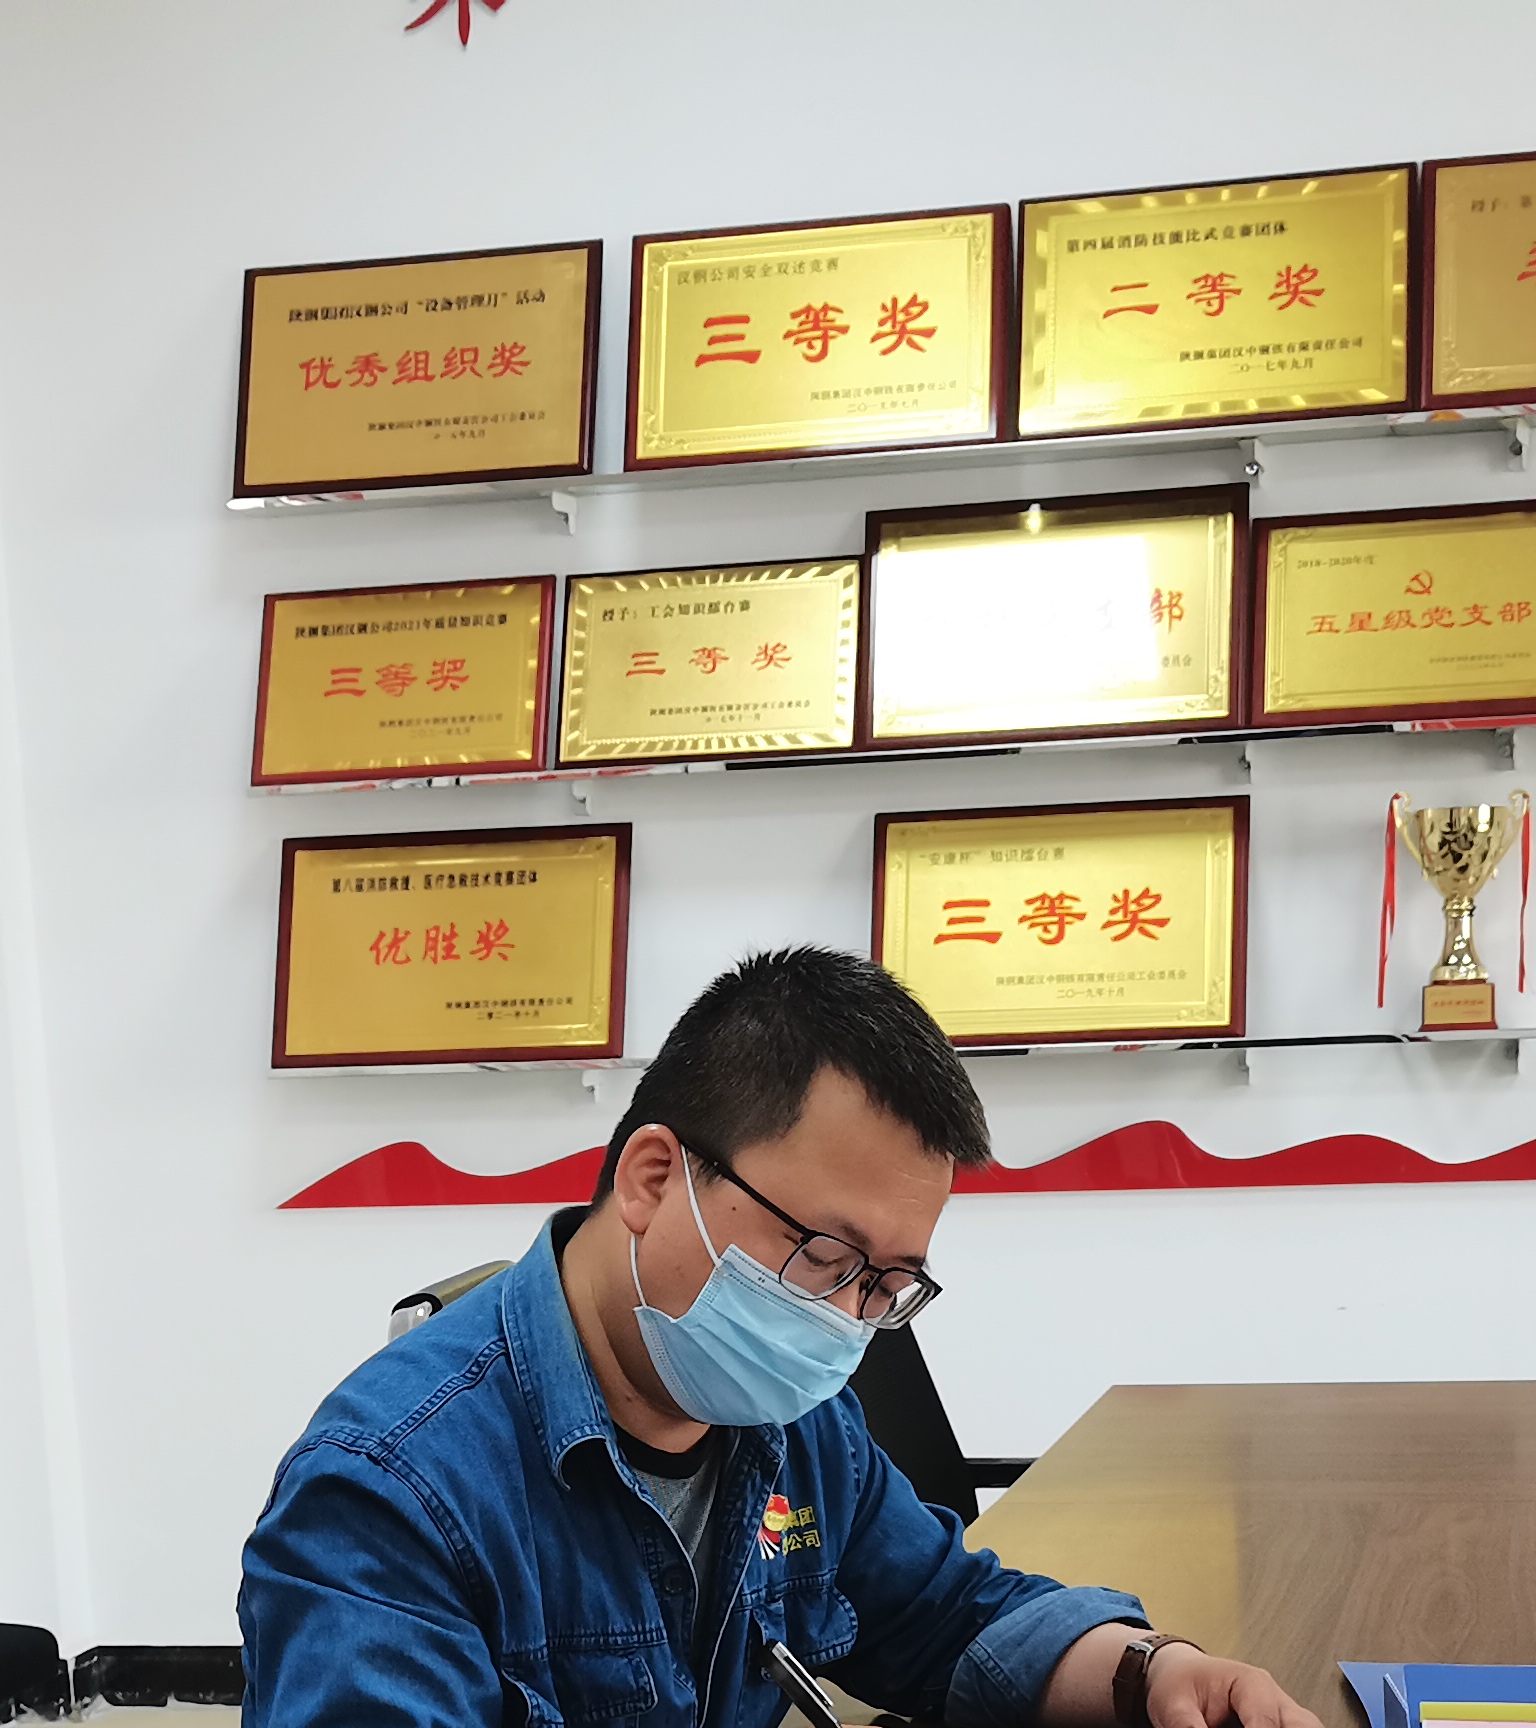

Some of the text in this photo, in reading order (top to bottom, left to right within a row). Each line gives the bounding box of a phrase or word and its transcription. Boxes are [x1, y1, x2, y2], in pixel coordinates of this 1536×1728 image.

[1066, 219, 1289, 254] 第四届消防技能比武竞赛团体
[1102, 263, 1326, 320] 二等奖
[694, 292, 939, 368] 三等奖
[298, 341, 532, 391] 优秀组织奖
[1305, 600, 1534, 636] 五星级党支部
[323, 658, 470, 697] 三等奖
[625, 641, 793, 678] 三等奖
[932, 886, 1172, 946] 三等奖
[368, 917, 516, 967] 优胜奖
